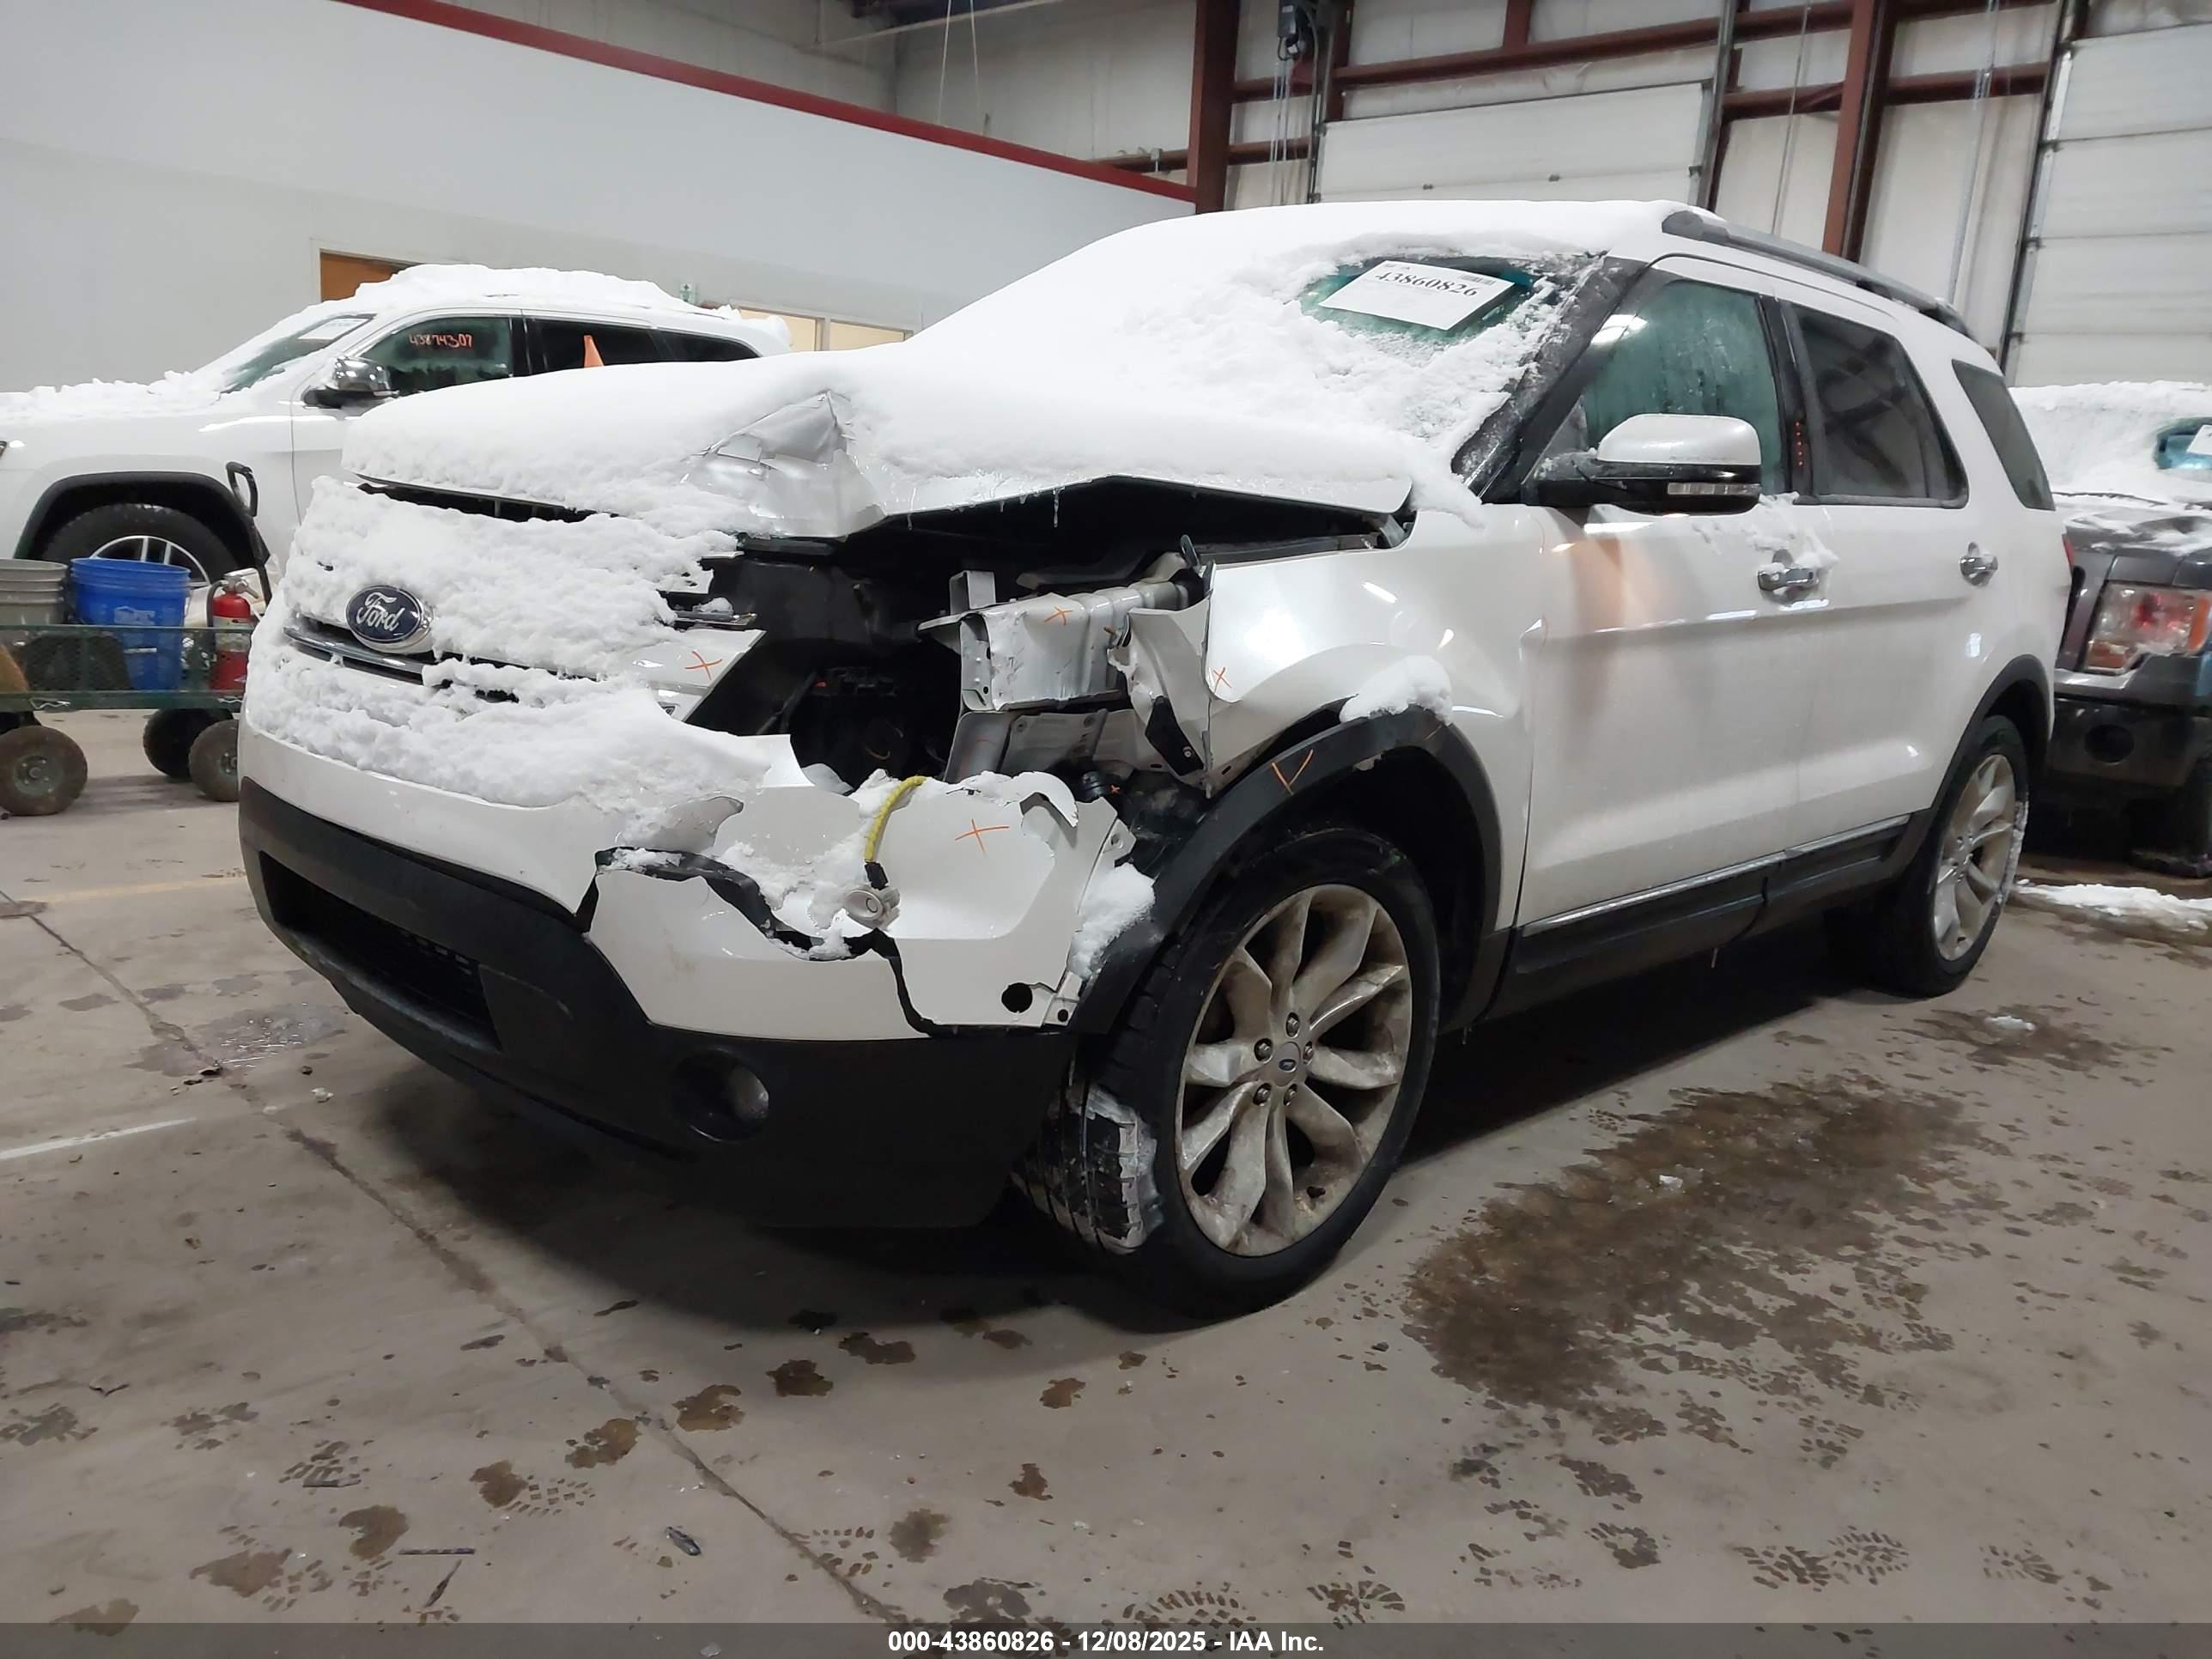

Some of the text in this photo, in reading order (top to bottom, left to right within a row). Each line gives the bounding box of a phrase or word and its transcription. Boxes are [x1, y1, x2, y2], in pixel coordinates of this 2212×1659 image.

[1374, 271, 1479, 296] 43860826
[408, 332, 473, 349] 43874307
[356, 592, 406, 632] Ford
